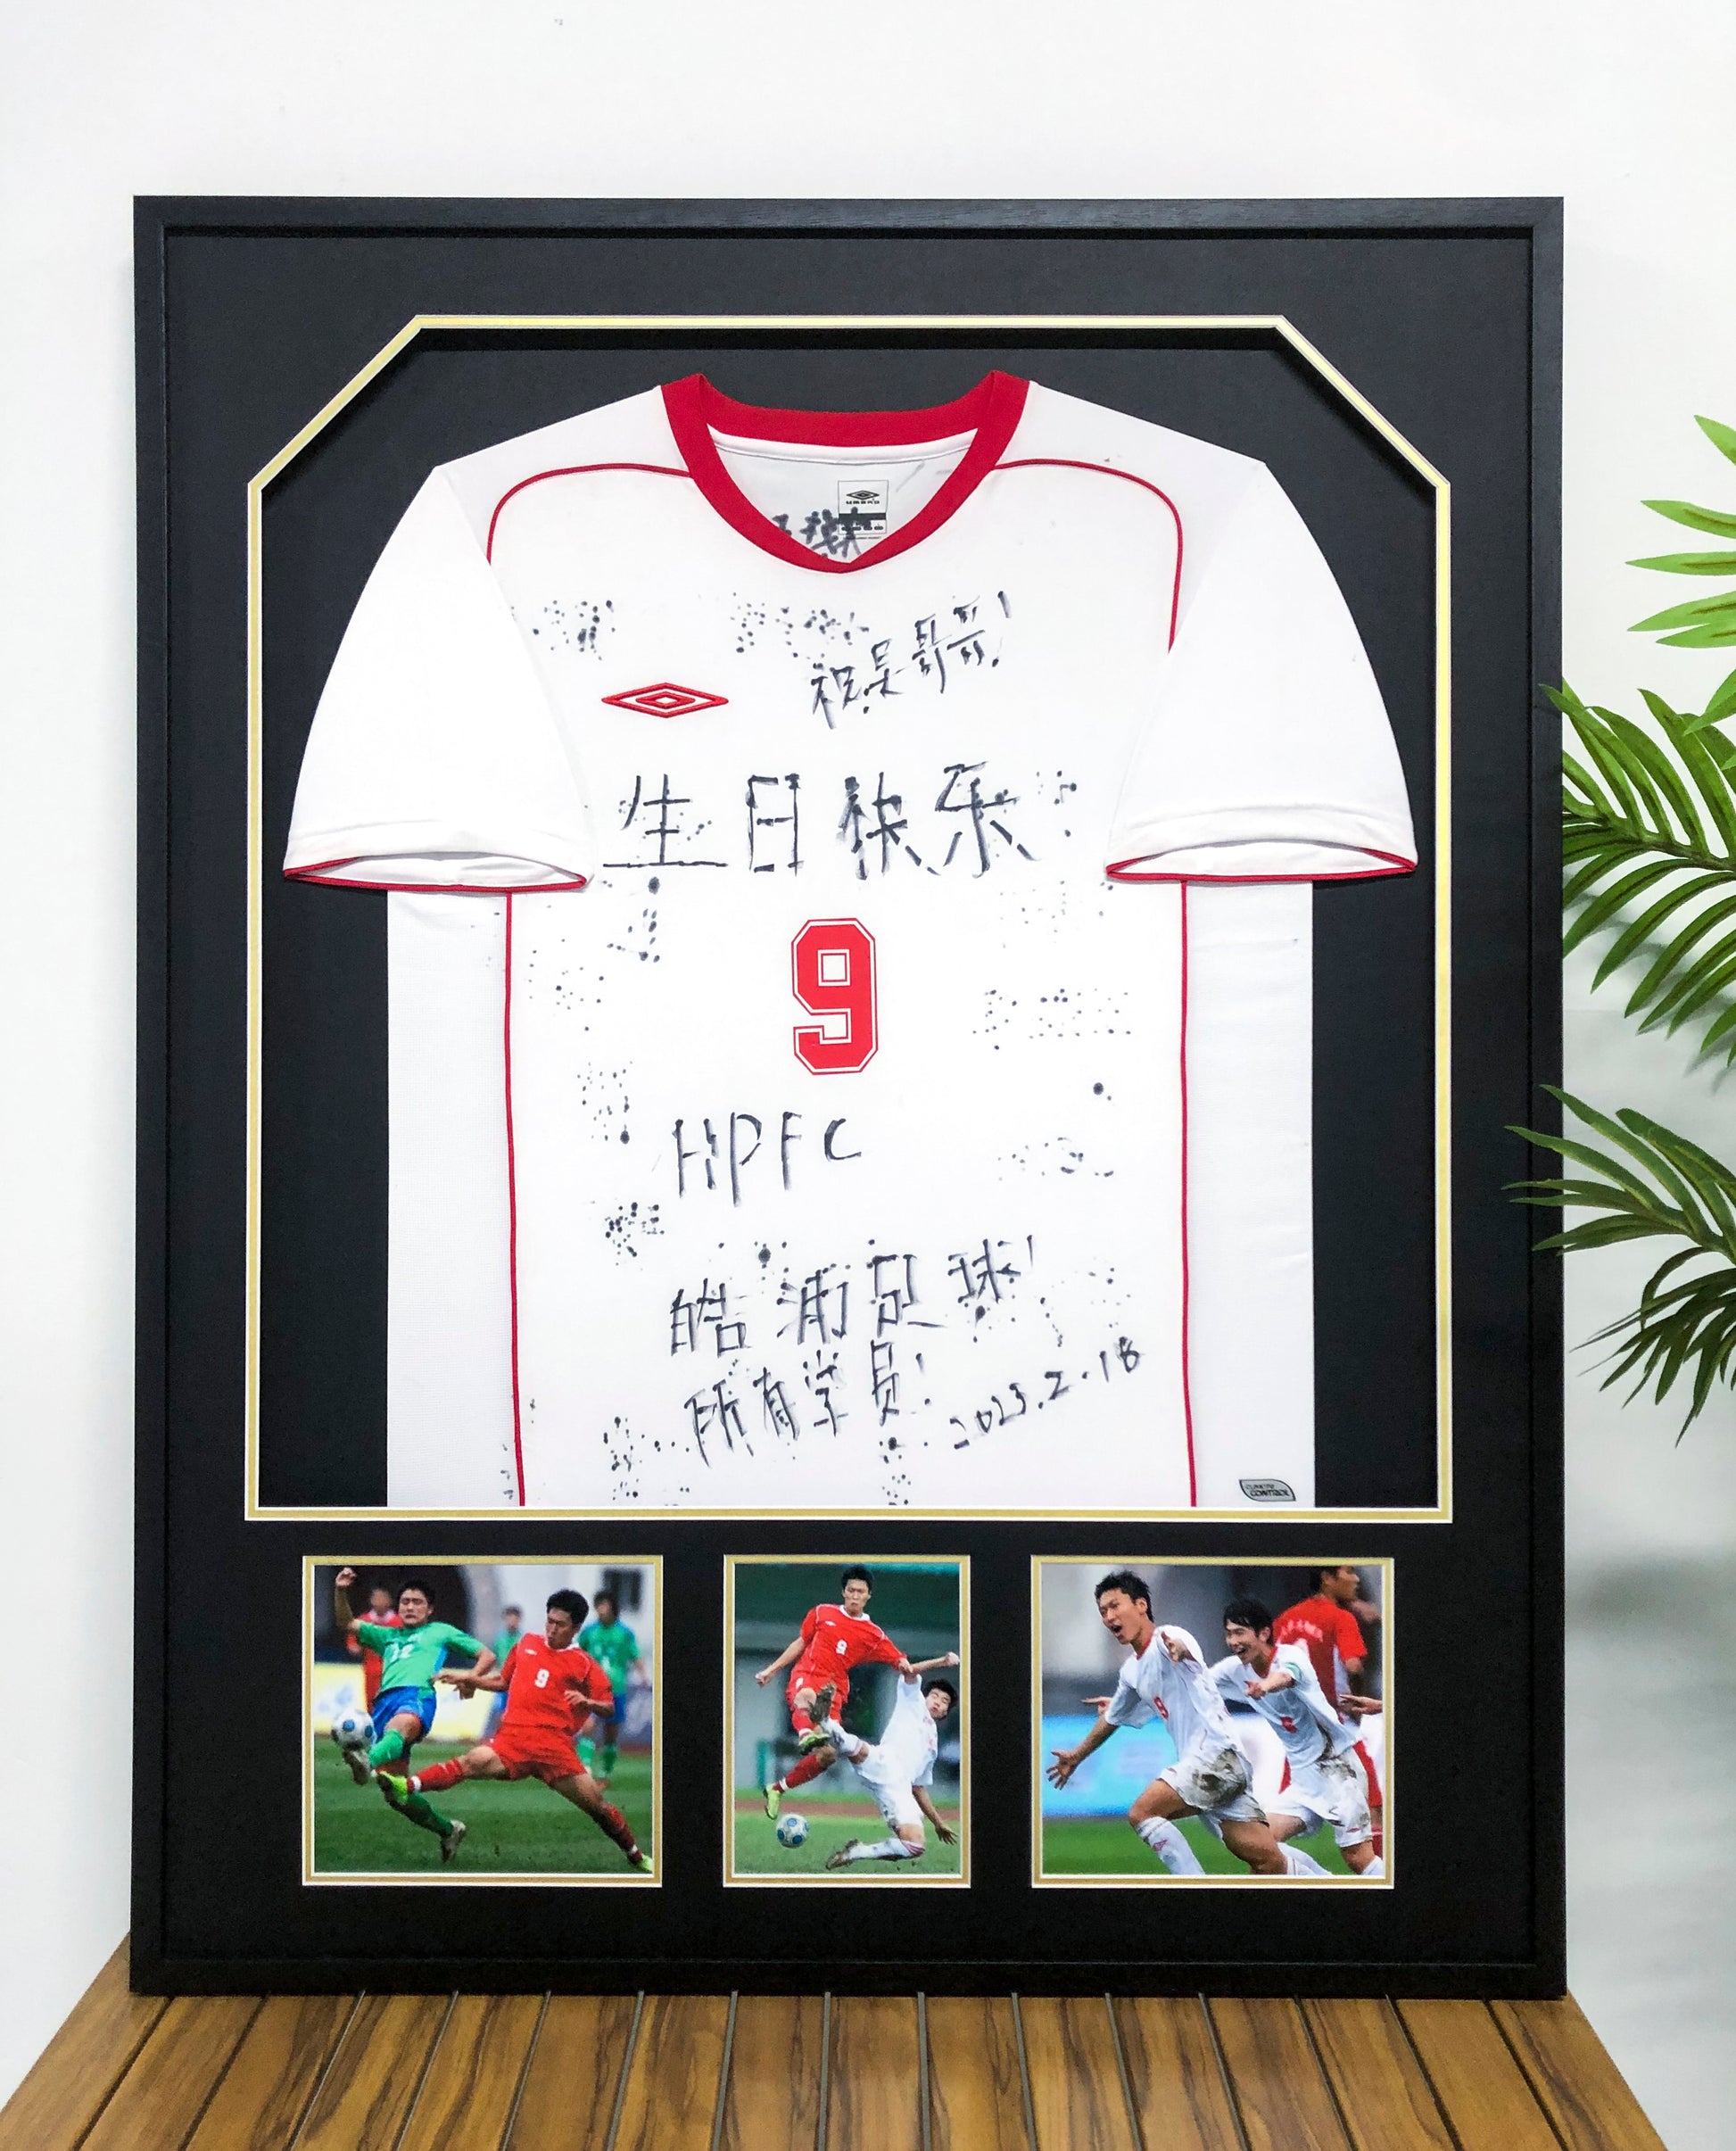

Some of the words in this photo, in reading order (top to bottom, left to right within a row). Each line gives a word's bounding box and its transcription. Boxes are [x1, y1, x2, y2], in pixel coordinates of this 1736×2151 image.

[603, 762, 1036, 880] 生日快乐
[791, 918, 878, 1075] 9
[534, 1667, 550, 1689] 9
